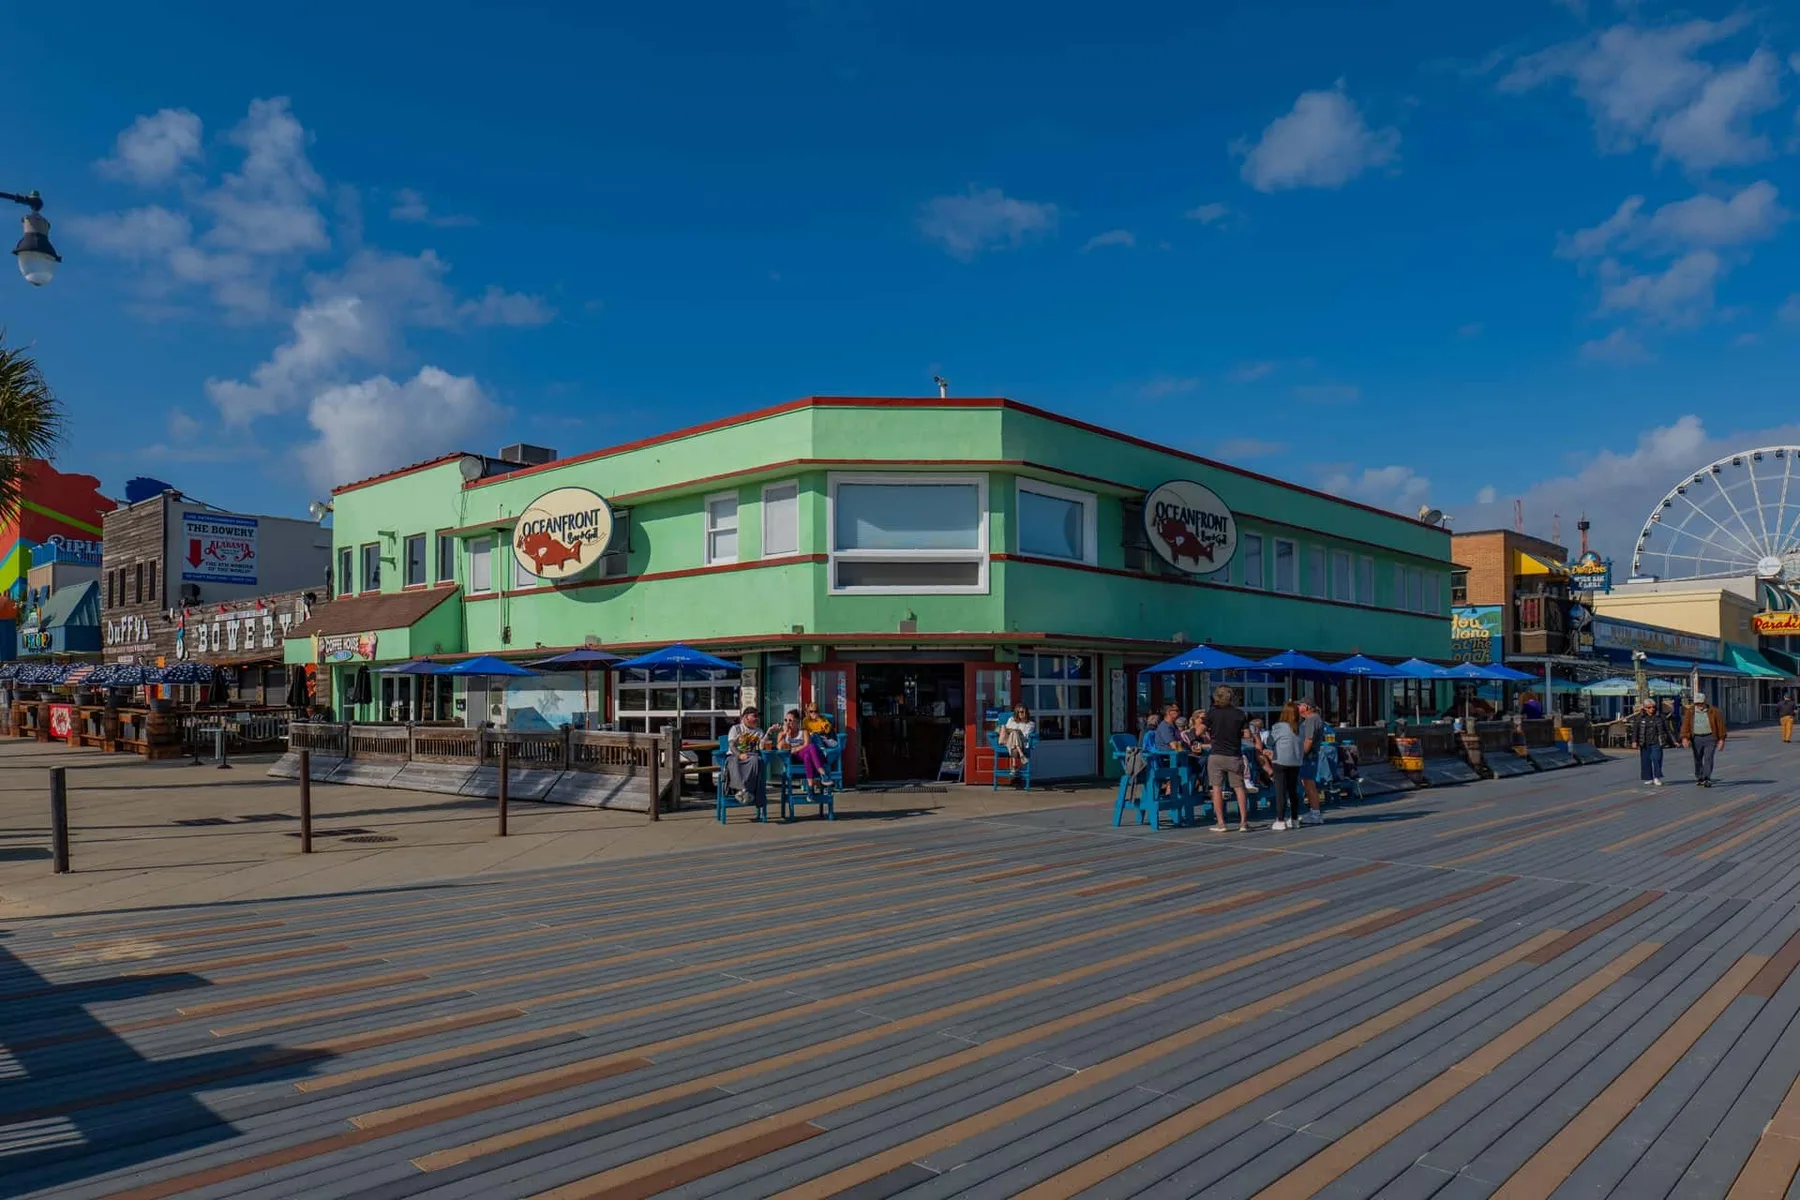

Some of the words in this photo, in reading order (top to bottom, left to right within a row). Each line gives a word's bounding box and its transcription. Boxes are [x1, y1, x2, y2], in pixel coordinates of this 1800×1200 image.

[187, 523, 209, 533] THE
[211, 525, 255, 537] BOWERY
[522, 508, 600, 542] OCEANFRONT
[1155, 501, 1228, 538] OCEANFRONT
[198, 613, 292, 652] BOWERY
